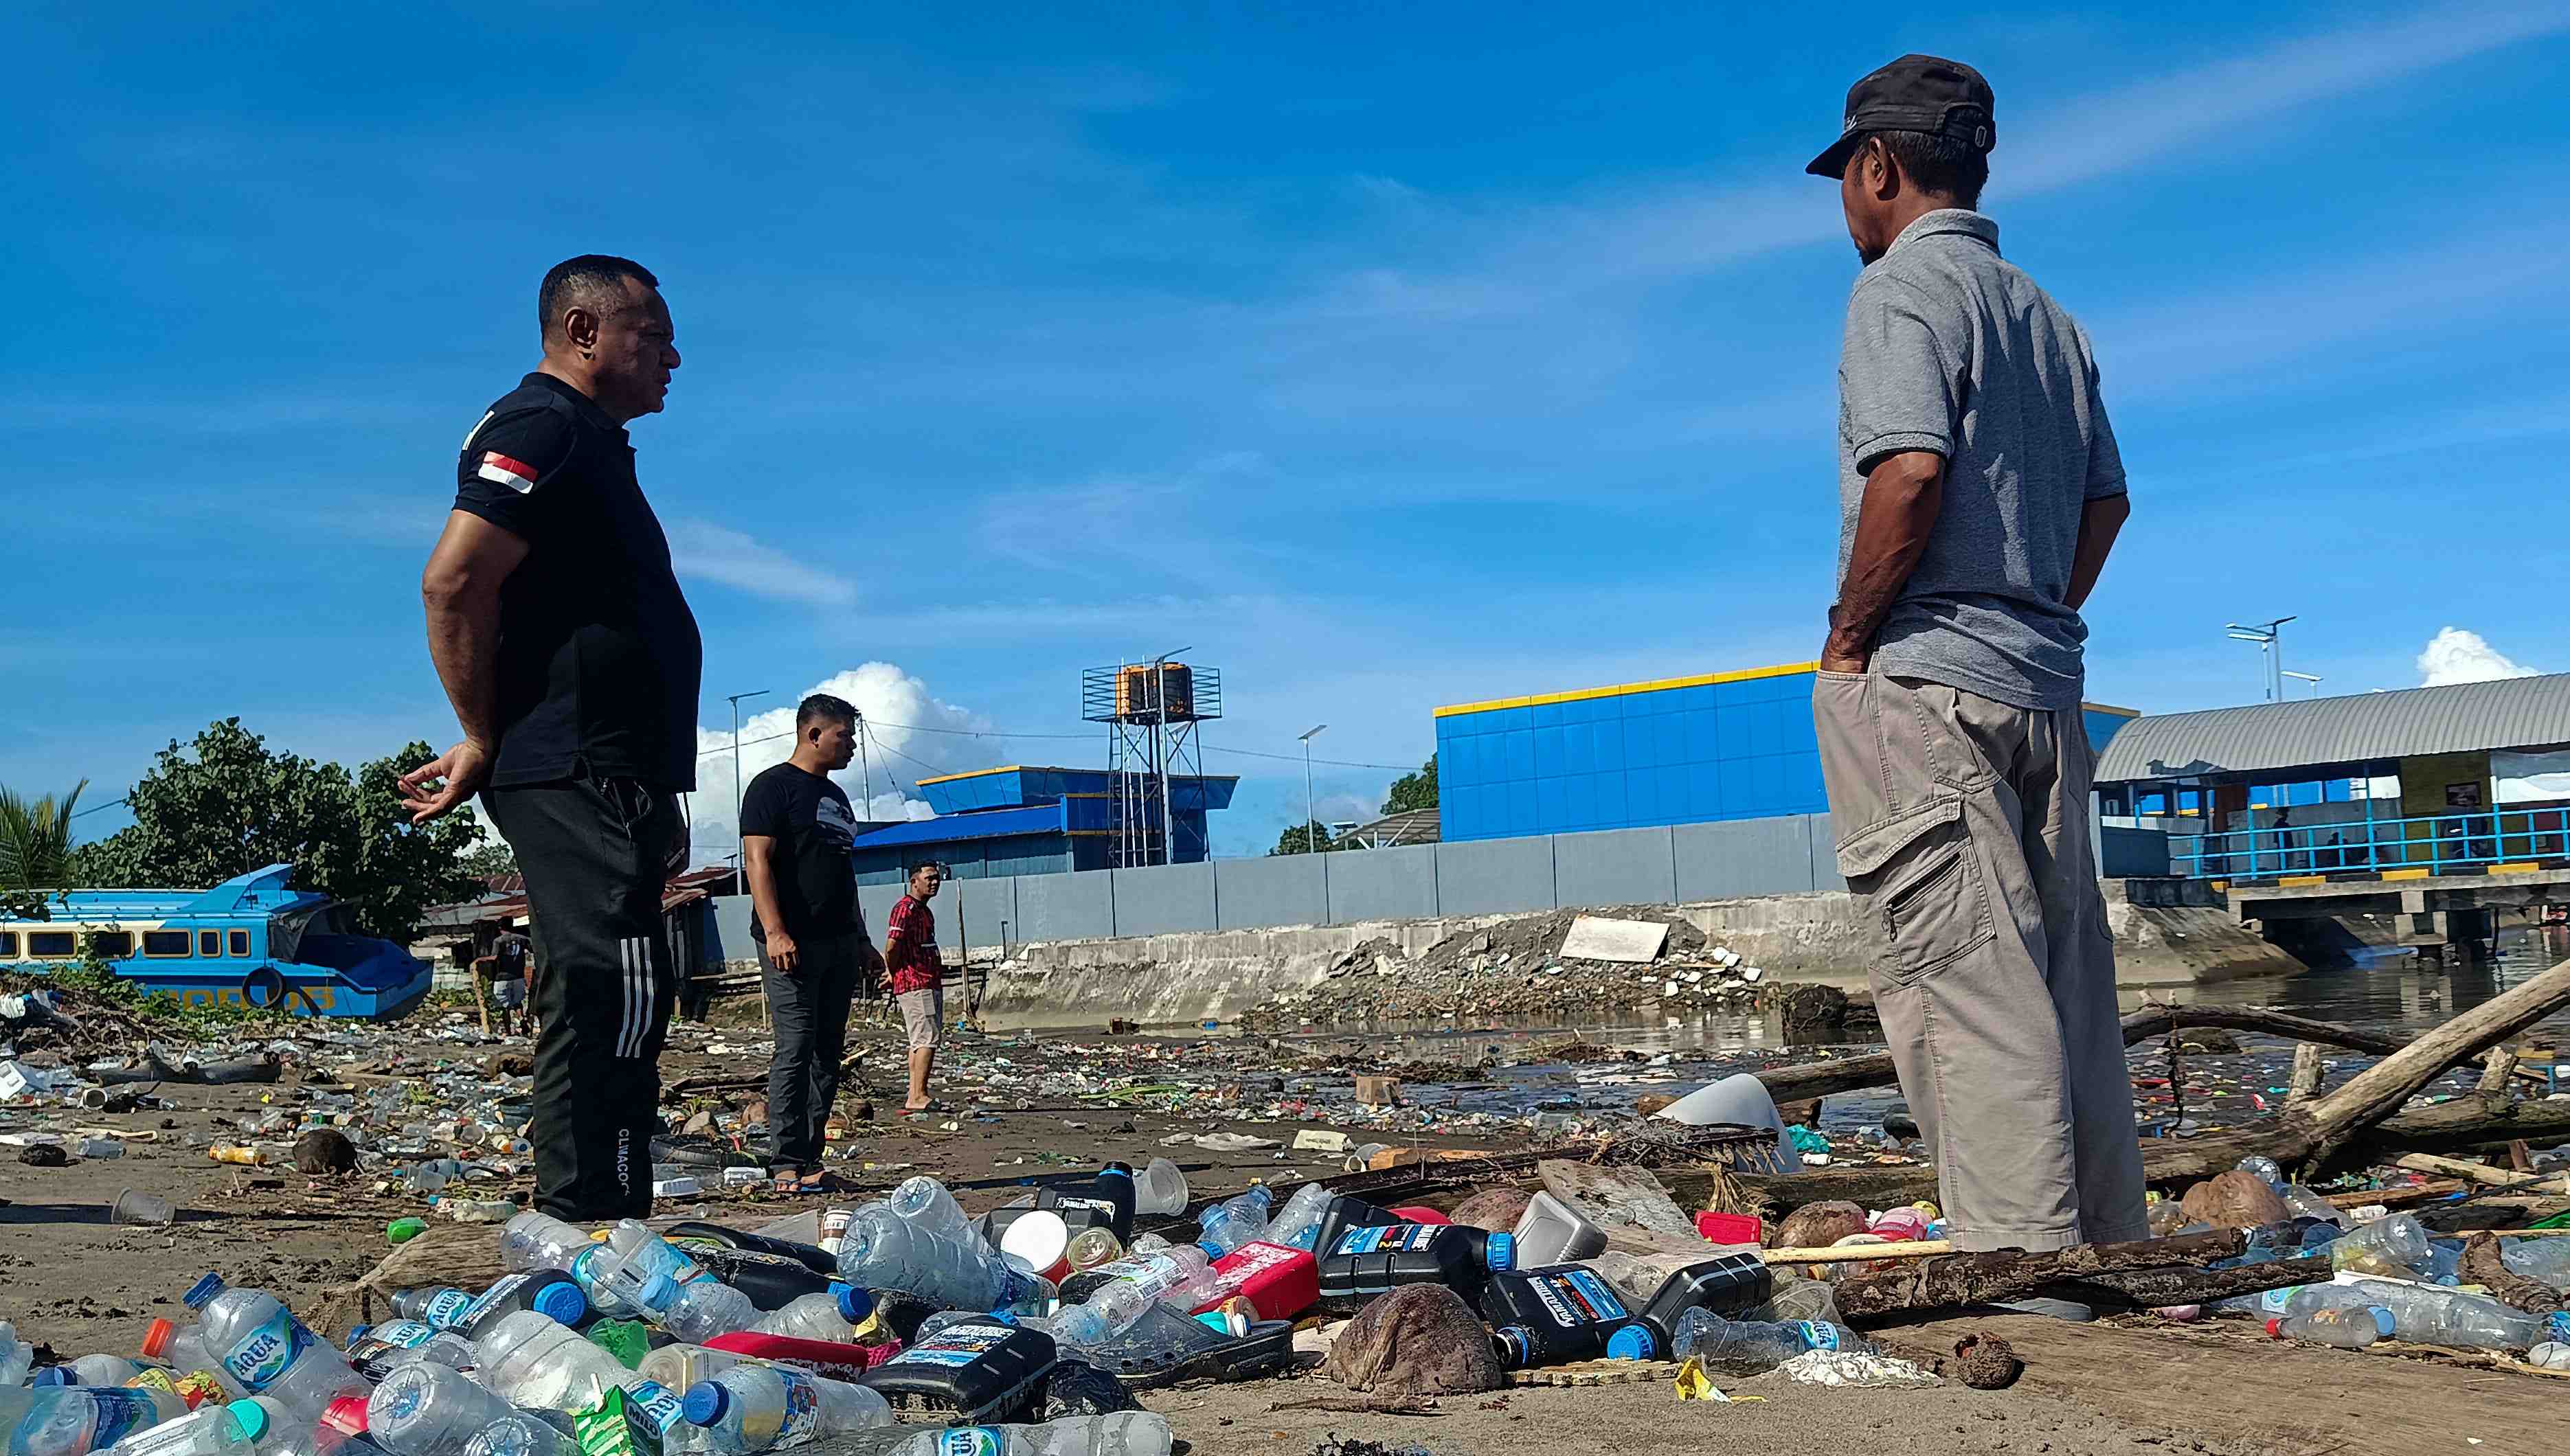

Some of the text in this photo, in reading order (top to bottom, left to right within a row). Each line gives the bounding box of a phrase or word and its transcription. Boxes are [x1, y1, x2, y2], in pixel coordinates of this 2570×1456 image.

[432, 1292, 460, 1325] AQUA
[392, 1323, 422, 1346] QUA
[232, 1333, 280, 1376] AQUA
[629, 1405, 659, 1437] MILO
[951, 1431, 976, 1456] UA
